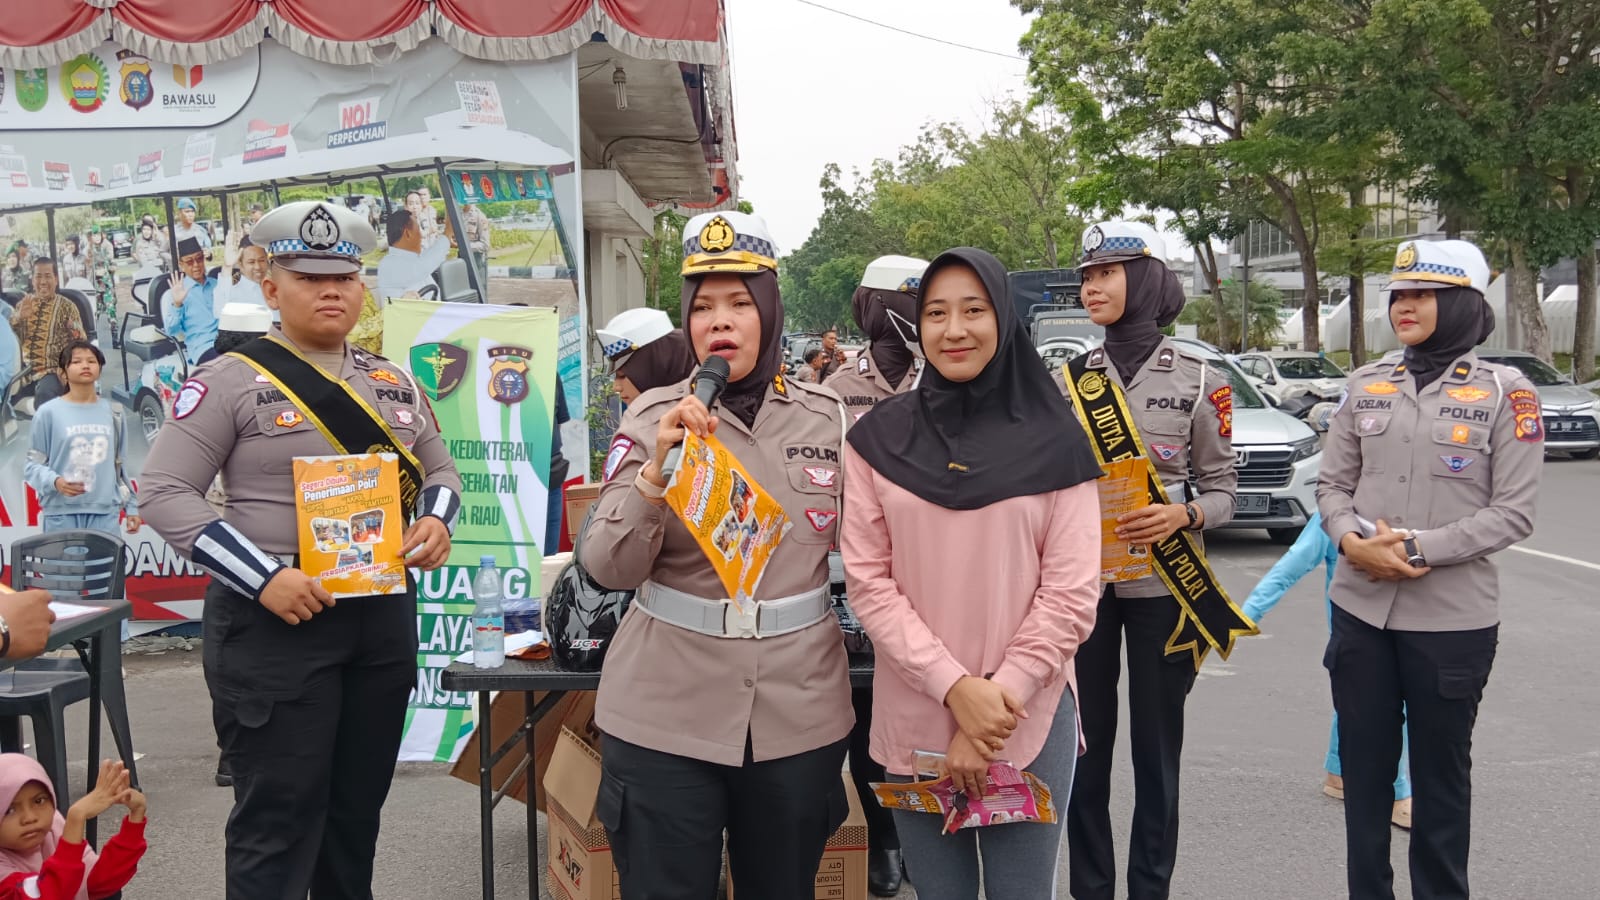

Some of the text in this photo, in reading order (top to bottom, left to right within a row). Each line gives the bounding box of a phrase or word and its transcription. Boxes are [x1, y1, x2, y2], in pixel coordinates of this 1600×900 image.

[162, 94, 216, 106] BAWASLU
[342, 102, 370, 129] NO!
[328, 124, 385, 146] PERPECAHAN
[493, 348, 528, 358] RIAU
[376, 388, 413, 405] POLRI
[1354, 399, 1393, 411] ADELINA
[1146, 398, 1193, 414] POLRI
[1438, 406, 1490, 423] POLRI
[66, 424, 111, 437] MICKEY
[1091, 404, 1127, 452] DUTA
[450, 440, 533, 462] KEDOKTERAN
[786, 446, 839, 464] POLRI
[301, 478, 324, 491] Segera
[304, 477, 378, 502] Penerimaan Polri
[460, 472, 518, 494] SEHATAN
[471, 506, 500, 526] RIAU
[1168, 553, 1209, 601] POLRI
